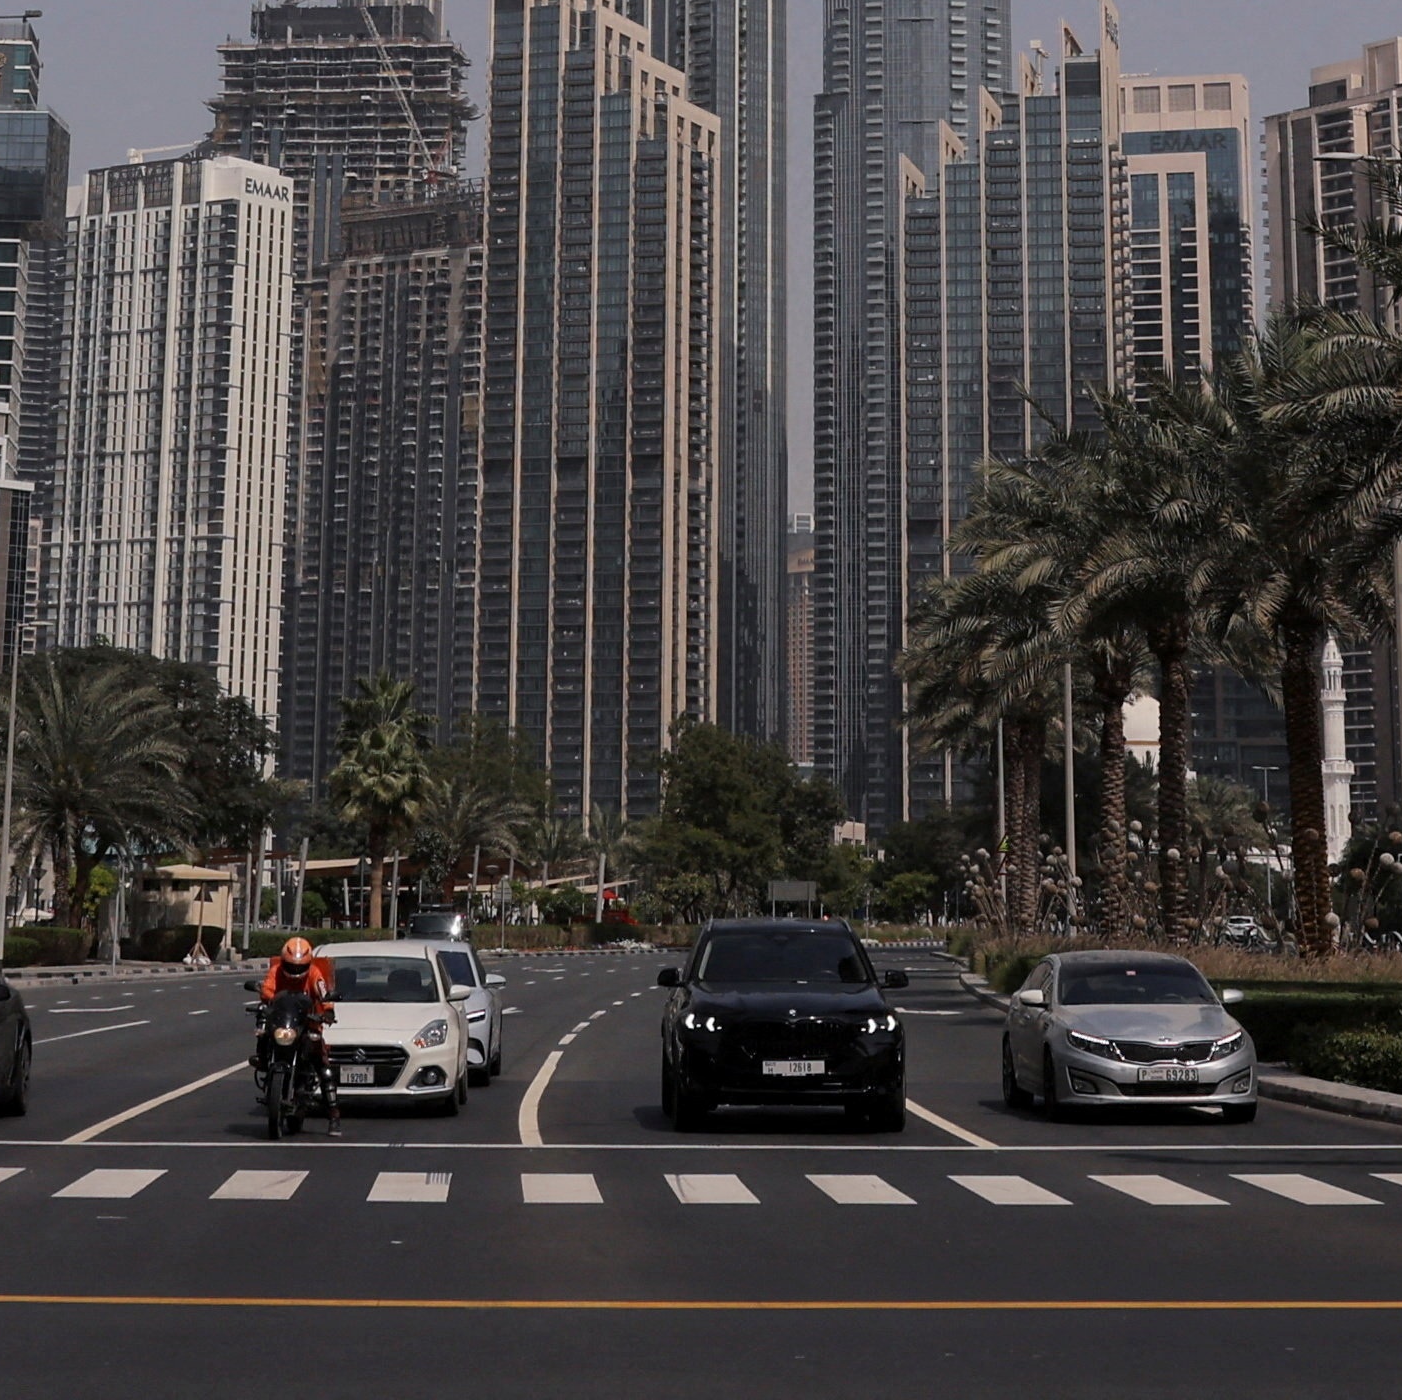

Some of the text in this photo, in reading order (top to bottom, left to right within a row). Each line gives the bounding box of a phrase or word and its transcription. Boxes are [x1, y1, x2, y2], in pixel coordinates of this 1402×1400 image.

[1150, 132, 1228, 153] EMAAR
[245, 177, 289, 202] EMAAR
[1141, 1069, 1147, 1080] P
[1166, 1069, 1197, 1081] 69283
